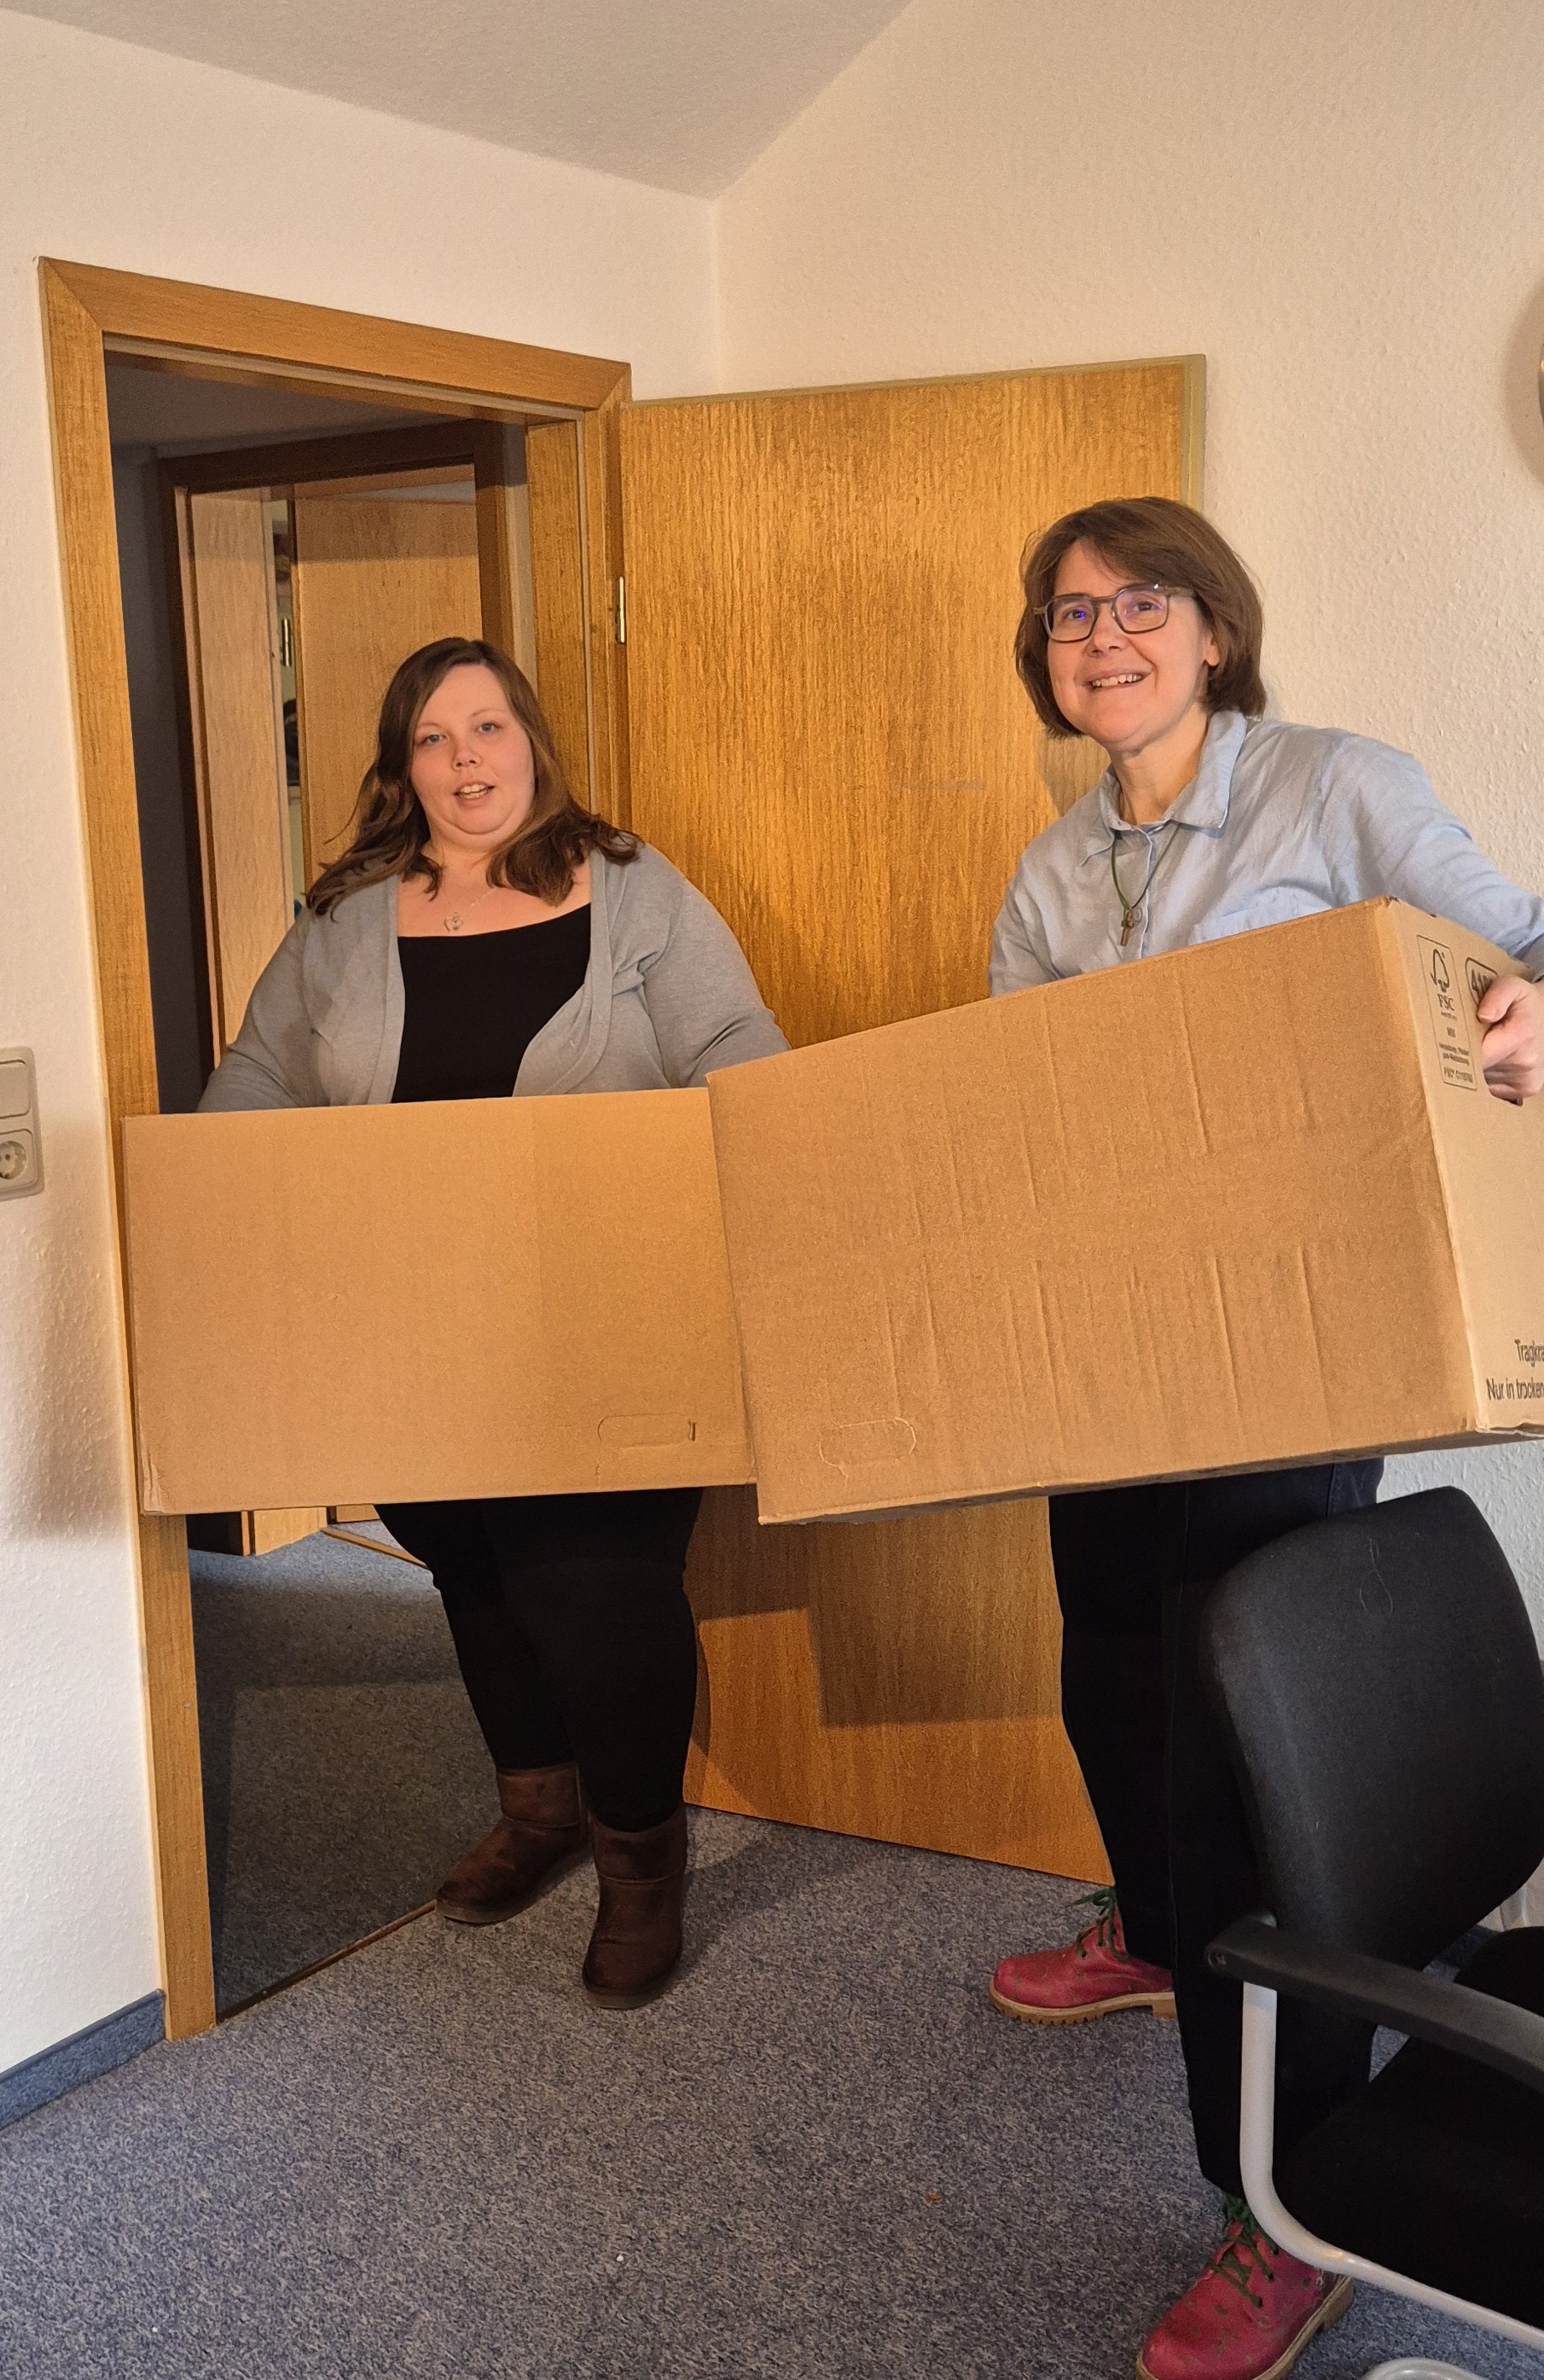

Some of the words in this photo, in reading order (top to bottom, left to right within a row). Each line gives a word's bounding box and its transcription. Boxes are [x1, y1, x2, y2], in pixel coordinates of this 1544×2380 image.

[1437, 994, 1455, 1011] FSC
[1486, 1377, 1504, 1400] Nur
[1506, 1377, 1515, 1399] in
